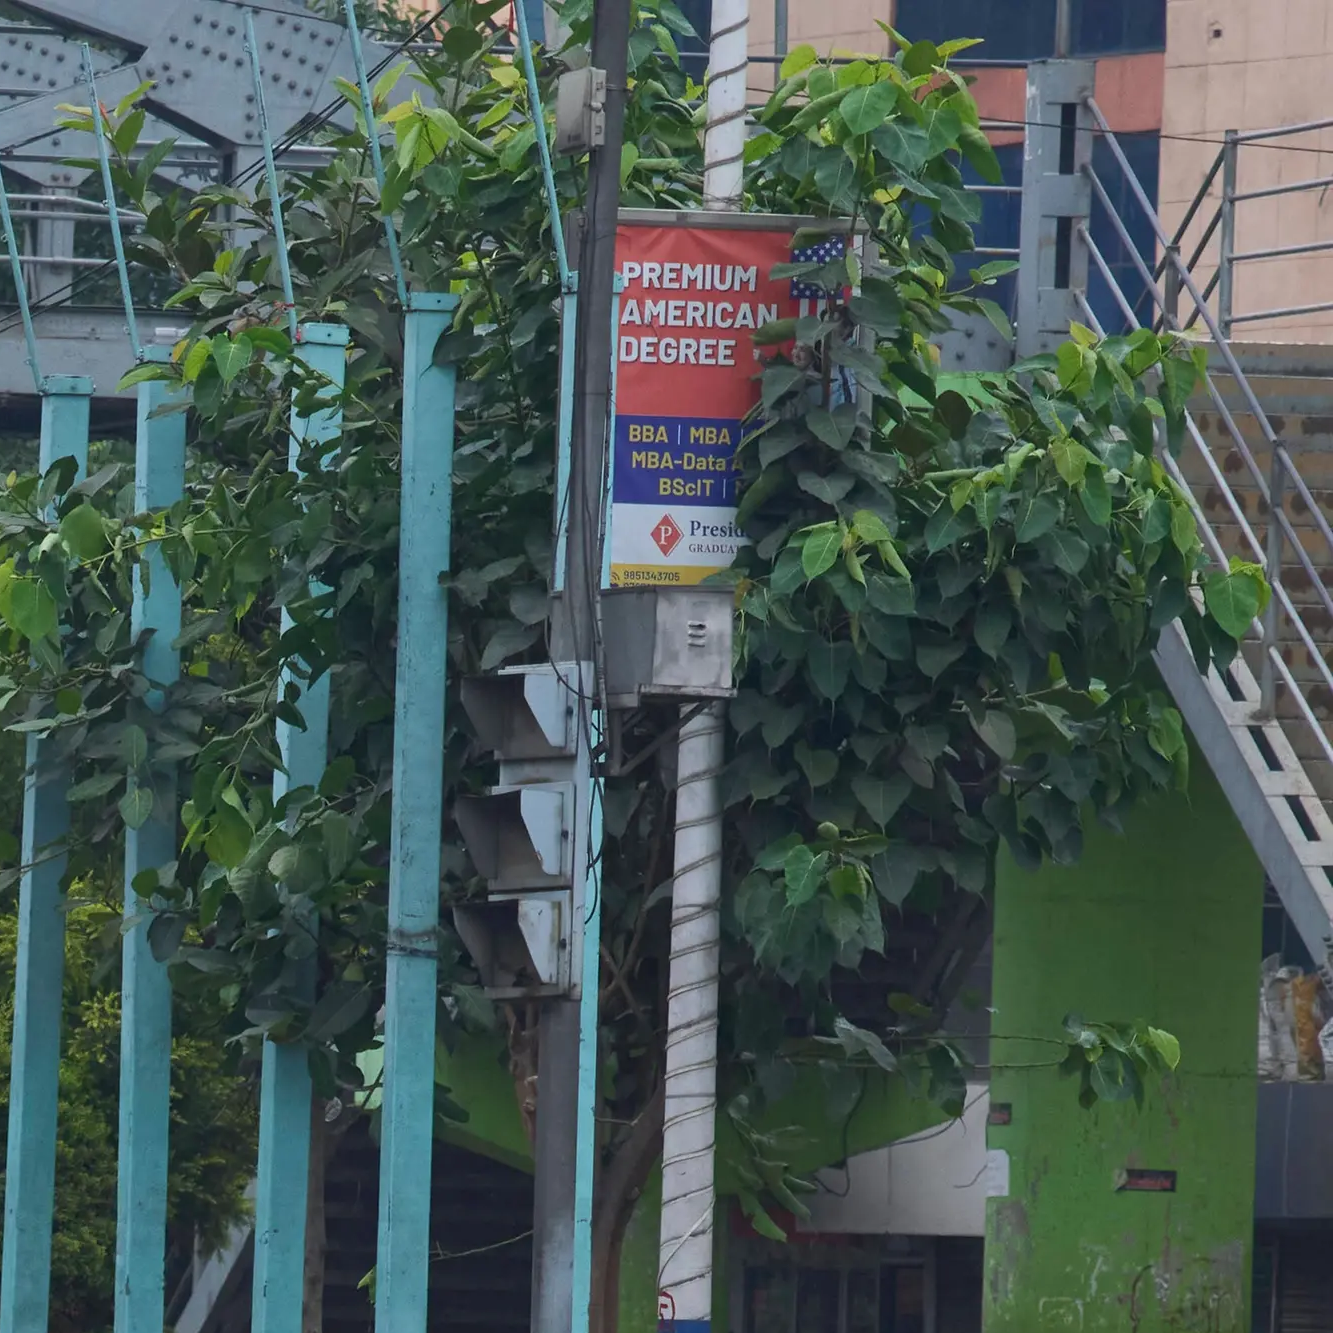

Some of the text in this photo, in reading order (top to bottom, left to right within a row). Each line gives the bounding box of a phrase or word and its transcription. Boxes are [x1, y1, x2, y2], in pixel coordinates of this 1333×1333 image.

[622, 260, 758, 293] PREMIUM
[620, 298, 778, 330] AMERICAN
[619, 335, 736, 366] DEGREE
[629, 424, 732, 445] BBA MBA
[632, 451, 727, 472] MBA-Data
[659, 478, 715, 497] BScIT
[623, 570, 680, 581] 9851343705
